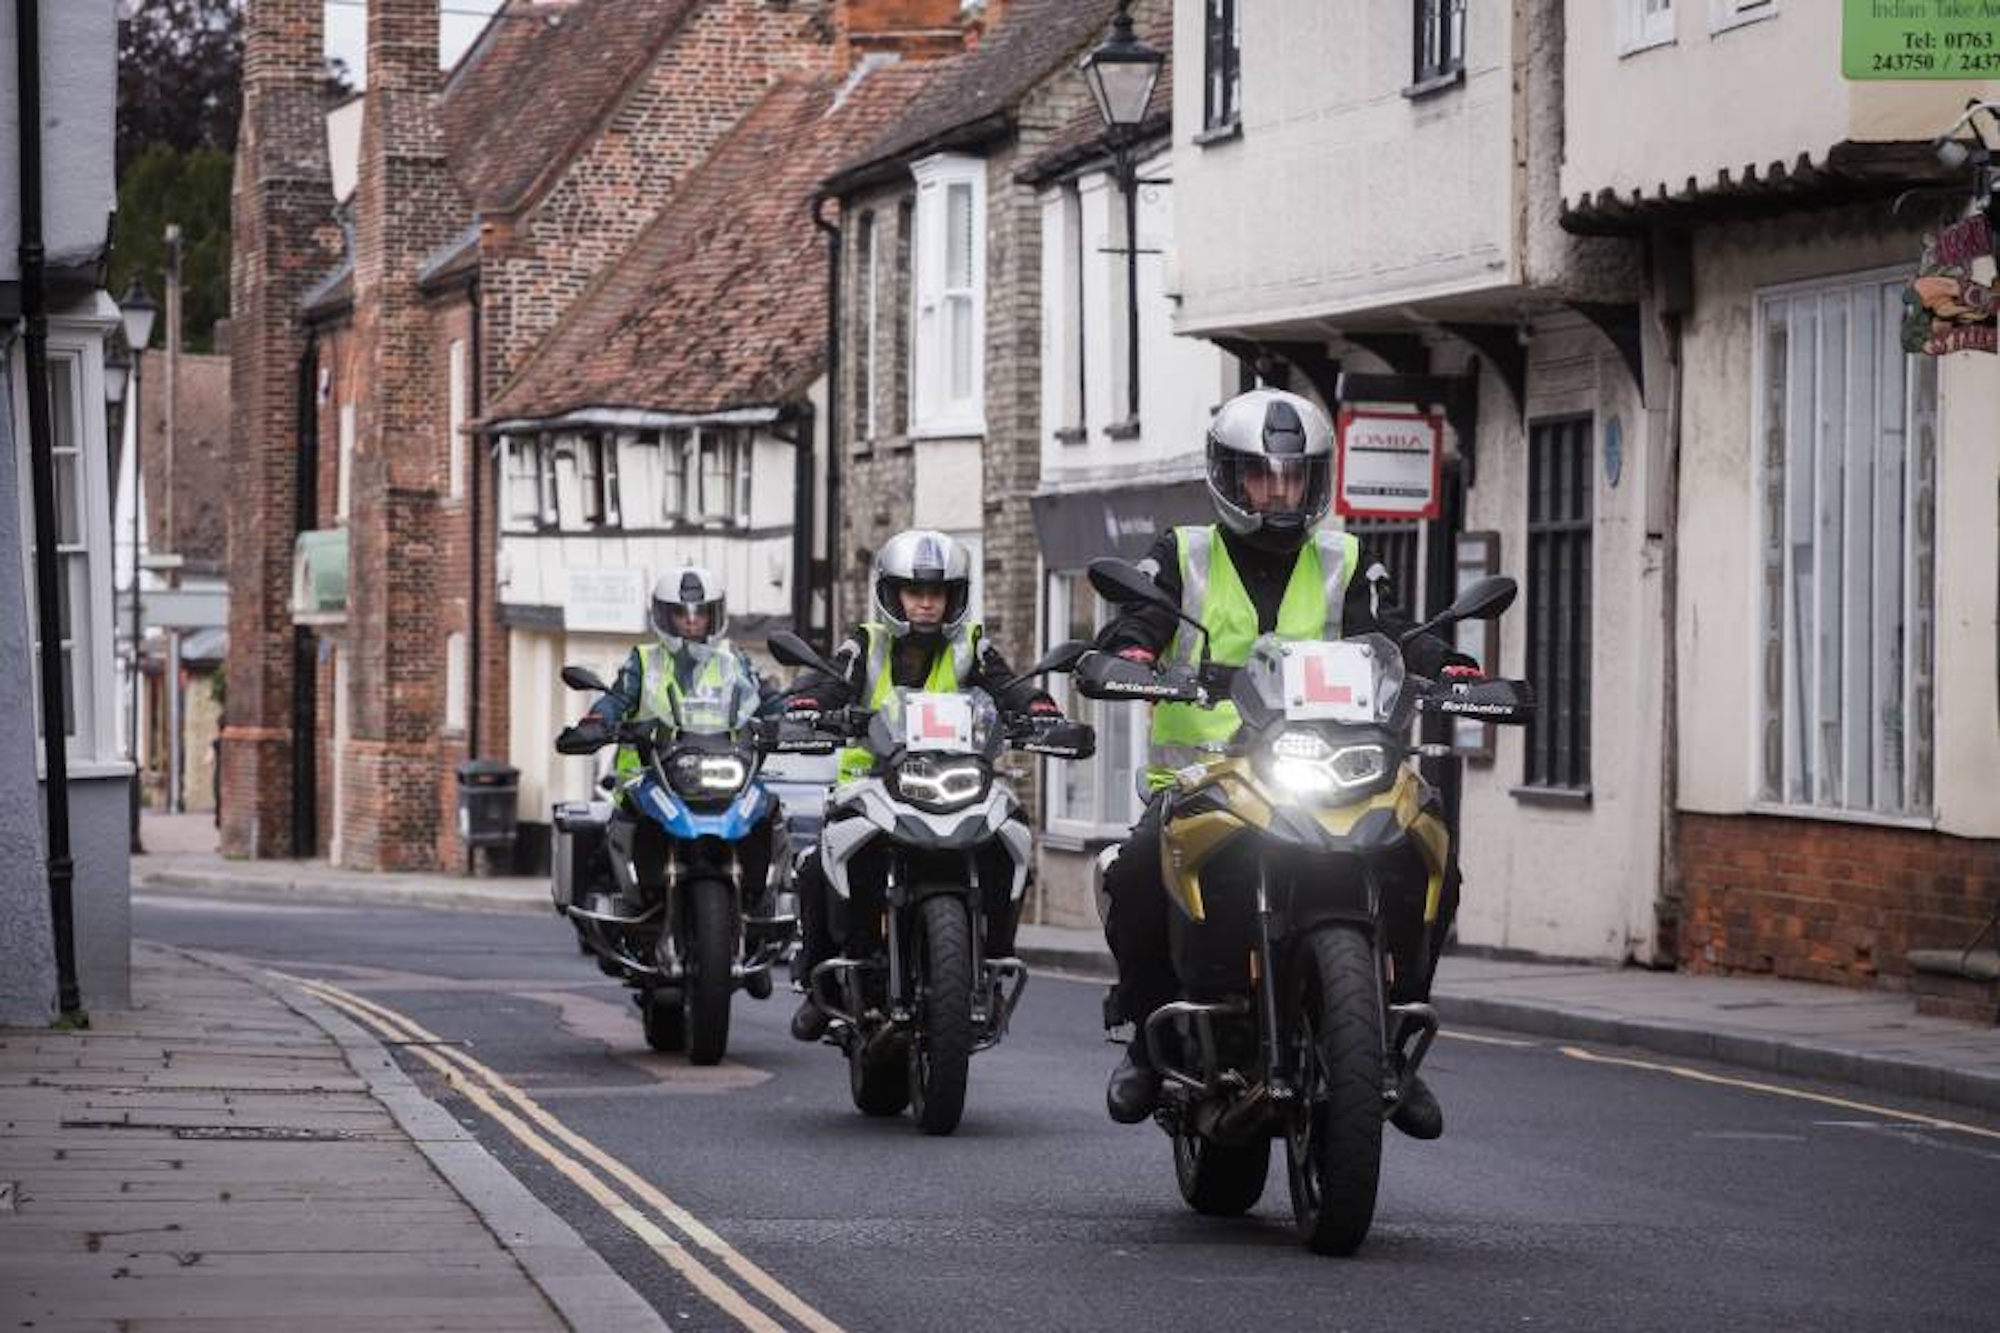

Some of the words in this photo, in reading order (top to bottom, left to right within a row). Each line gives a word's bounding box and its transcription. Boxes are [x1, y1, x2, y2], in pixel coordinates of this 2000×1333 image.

[1873, 0, 1924, 18] Indian
[1934, 0, 1973, 18] Take
[1903, 32, 1936, 48] Tel:
[1945, 32, 1992, 49] 01763
[1873, 54, 1934, 70] 243750
[1304, 655, 1352, 704] L
[923, 704, 956, 738] L
